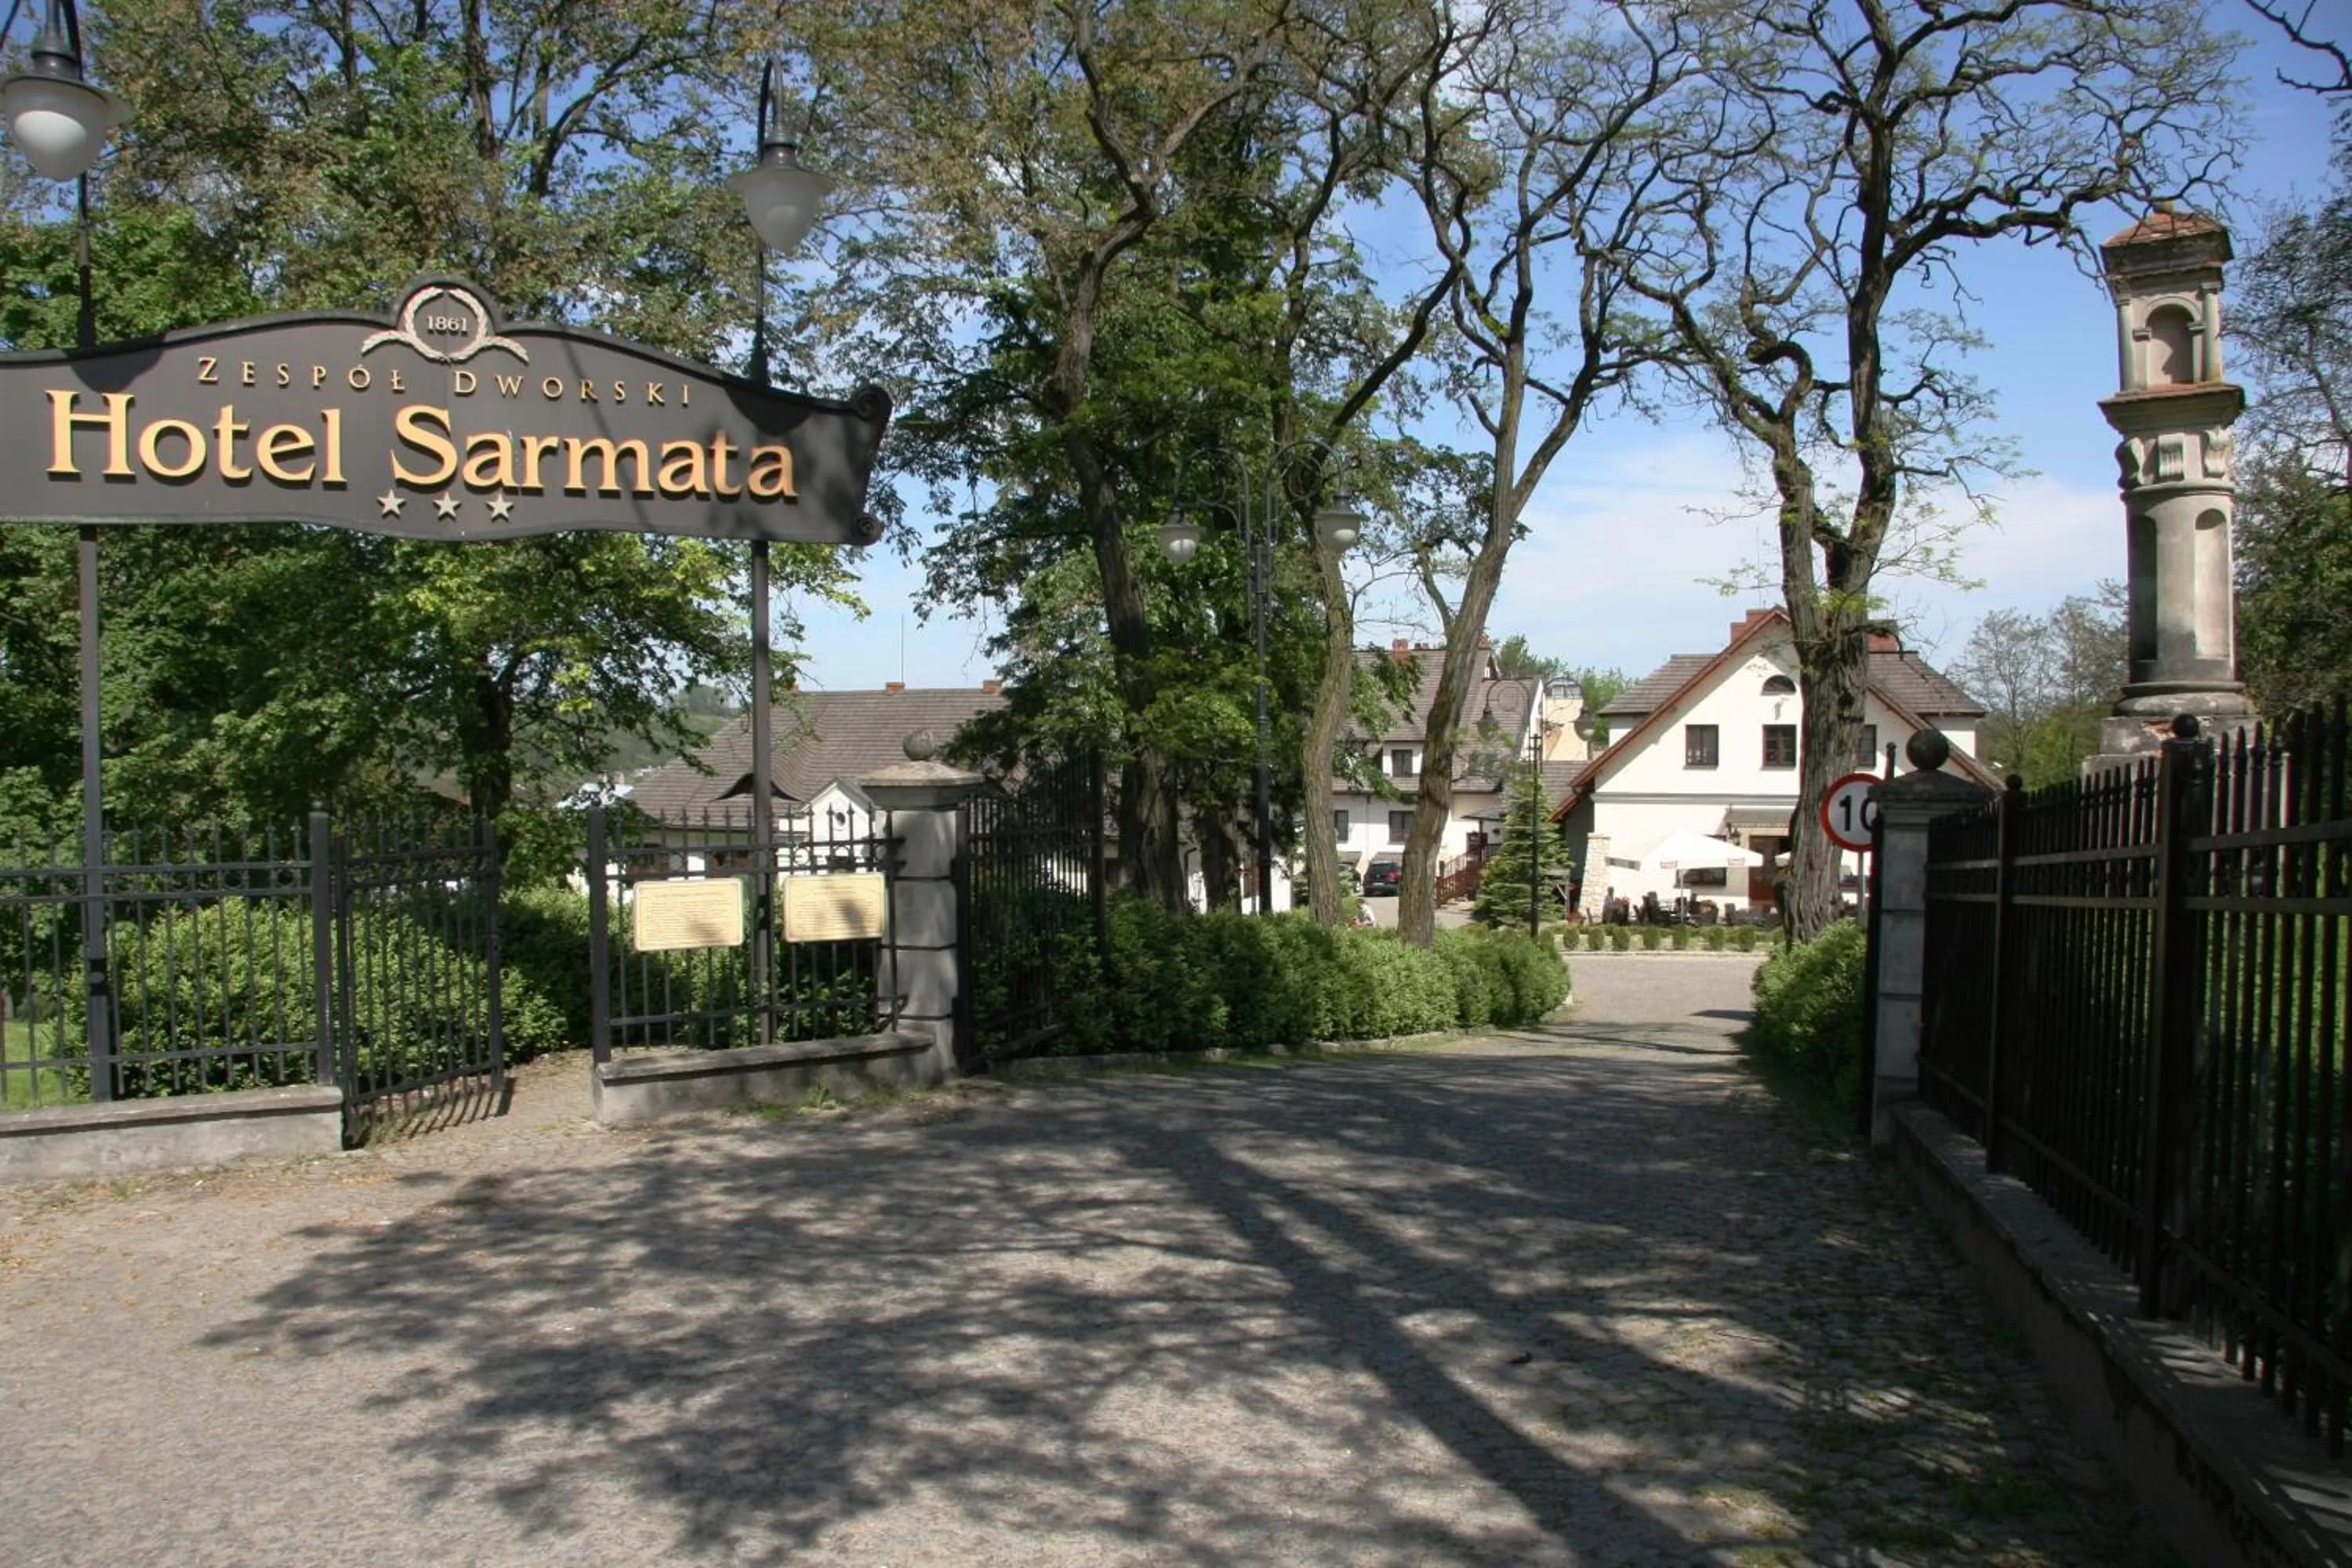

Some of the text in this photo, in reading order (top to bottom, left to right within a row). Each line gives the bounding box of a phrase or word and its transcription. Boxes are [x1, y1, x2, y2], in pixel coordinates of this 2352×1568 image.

[426, 315, 468, 332] 1861
[198, 357, 690, 405] ZESPÓŁ DWORSKI
[45, 390, 799, 497] Hotel Sarmata
